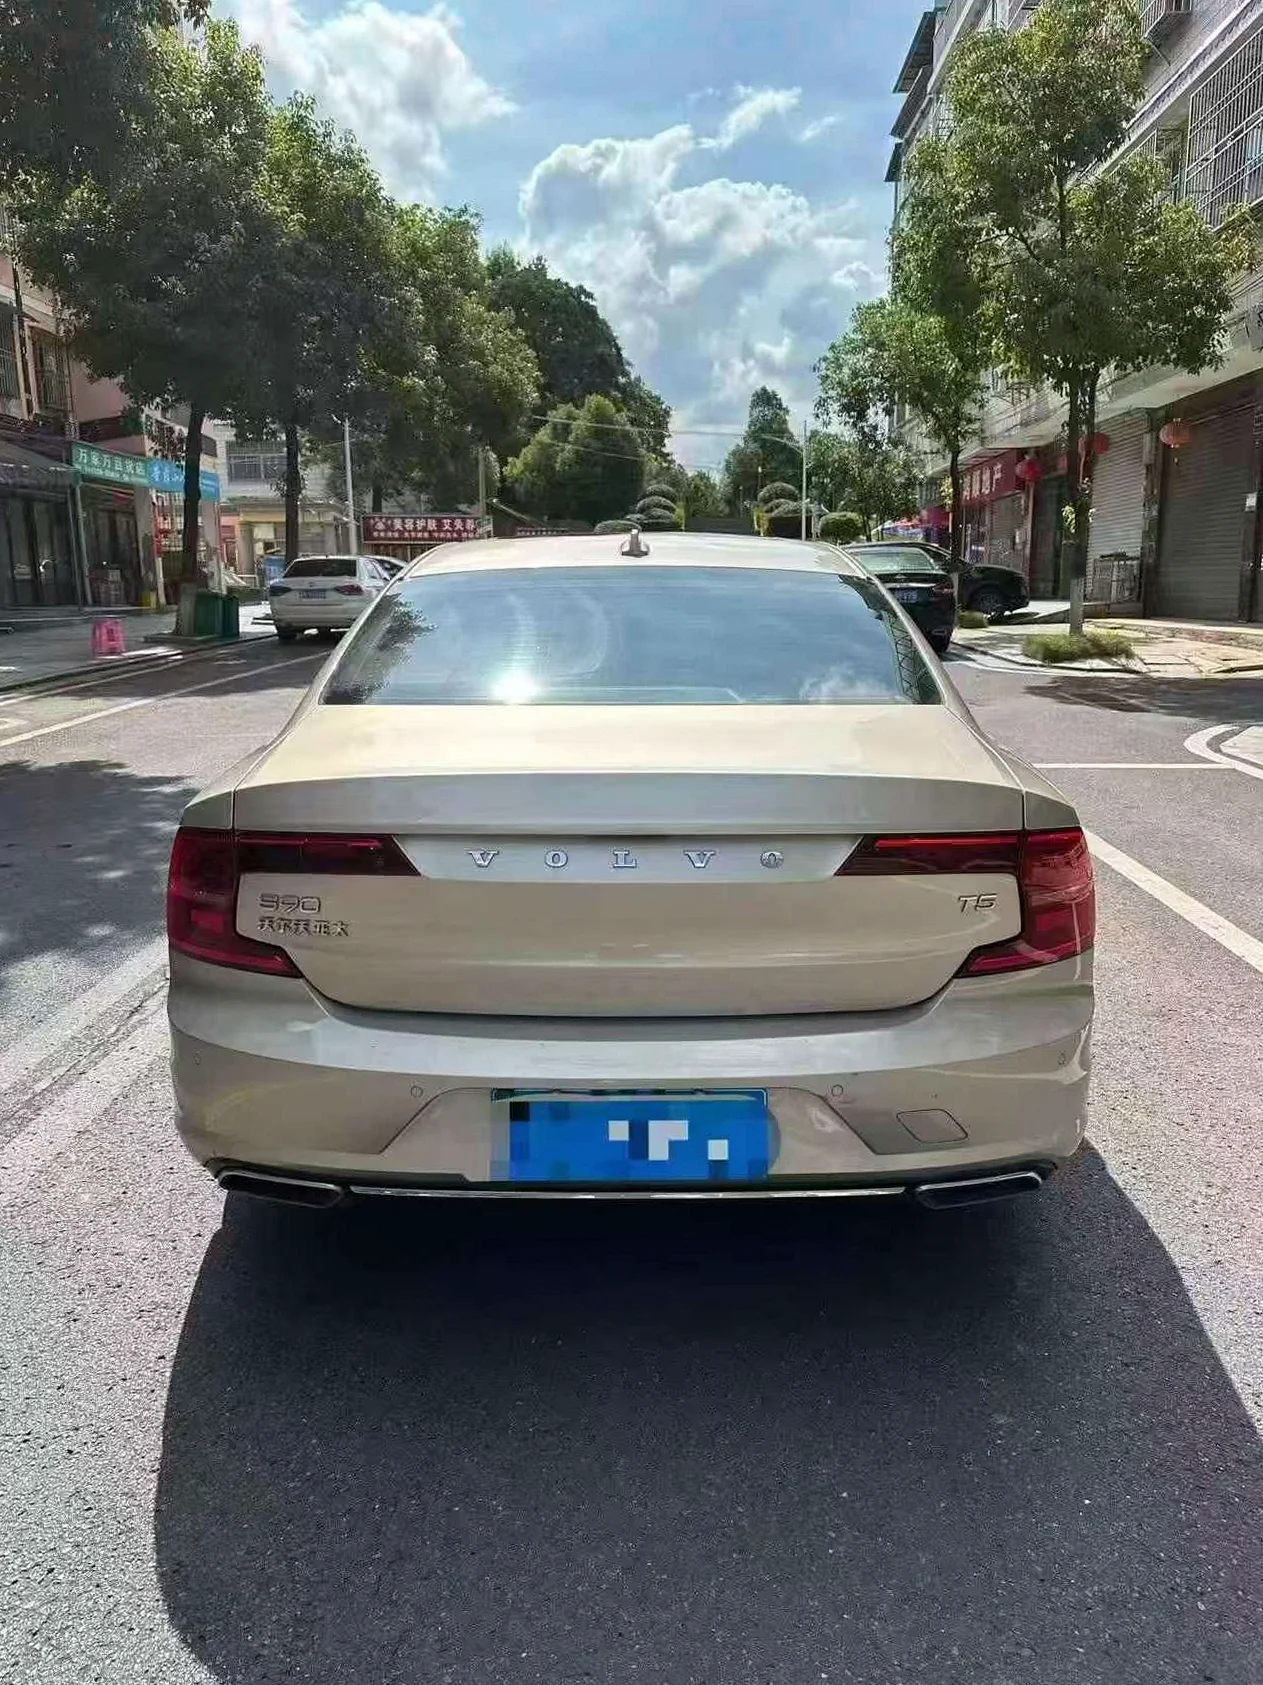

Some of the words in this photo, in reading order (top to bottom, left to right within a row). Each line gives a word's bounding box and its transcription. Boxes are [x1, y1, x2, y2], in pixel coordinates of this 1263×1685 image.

[393, 518, 437, 530] 美容护肤
[467, 848, 785, 869] VOLVO
[259, 892, 321, 914] S90
[958, 892, 998, 913] T5
